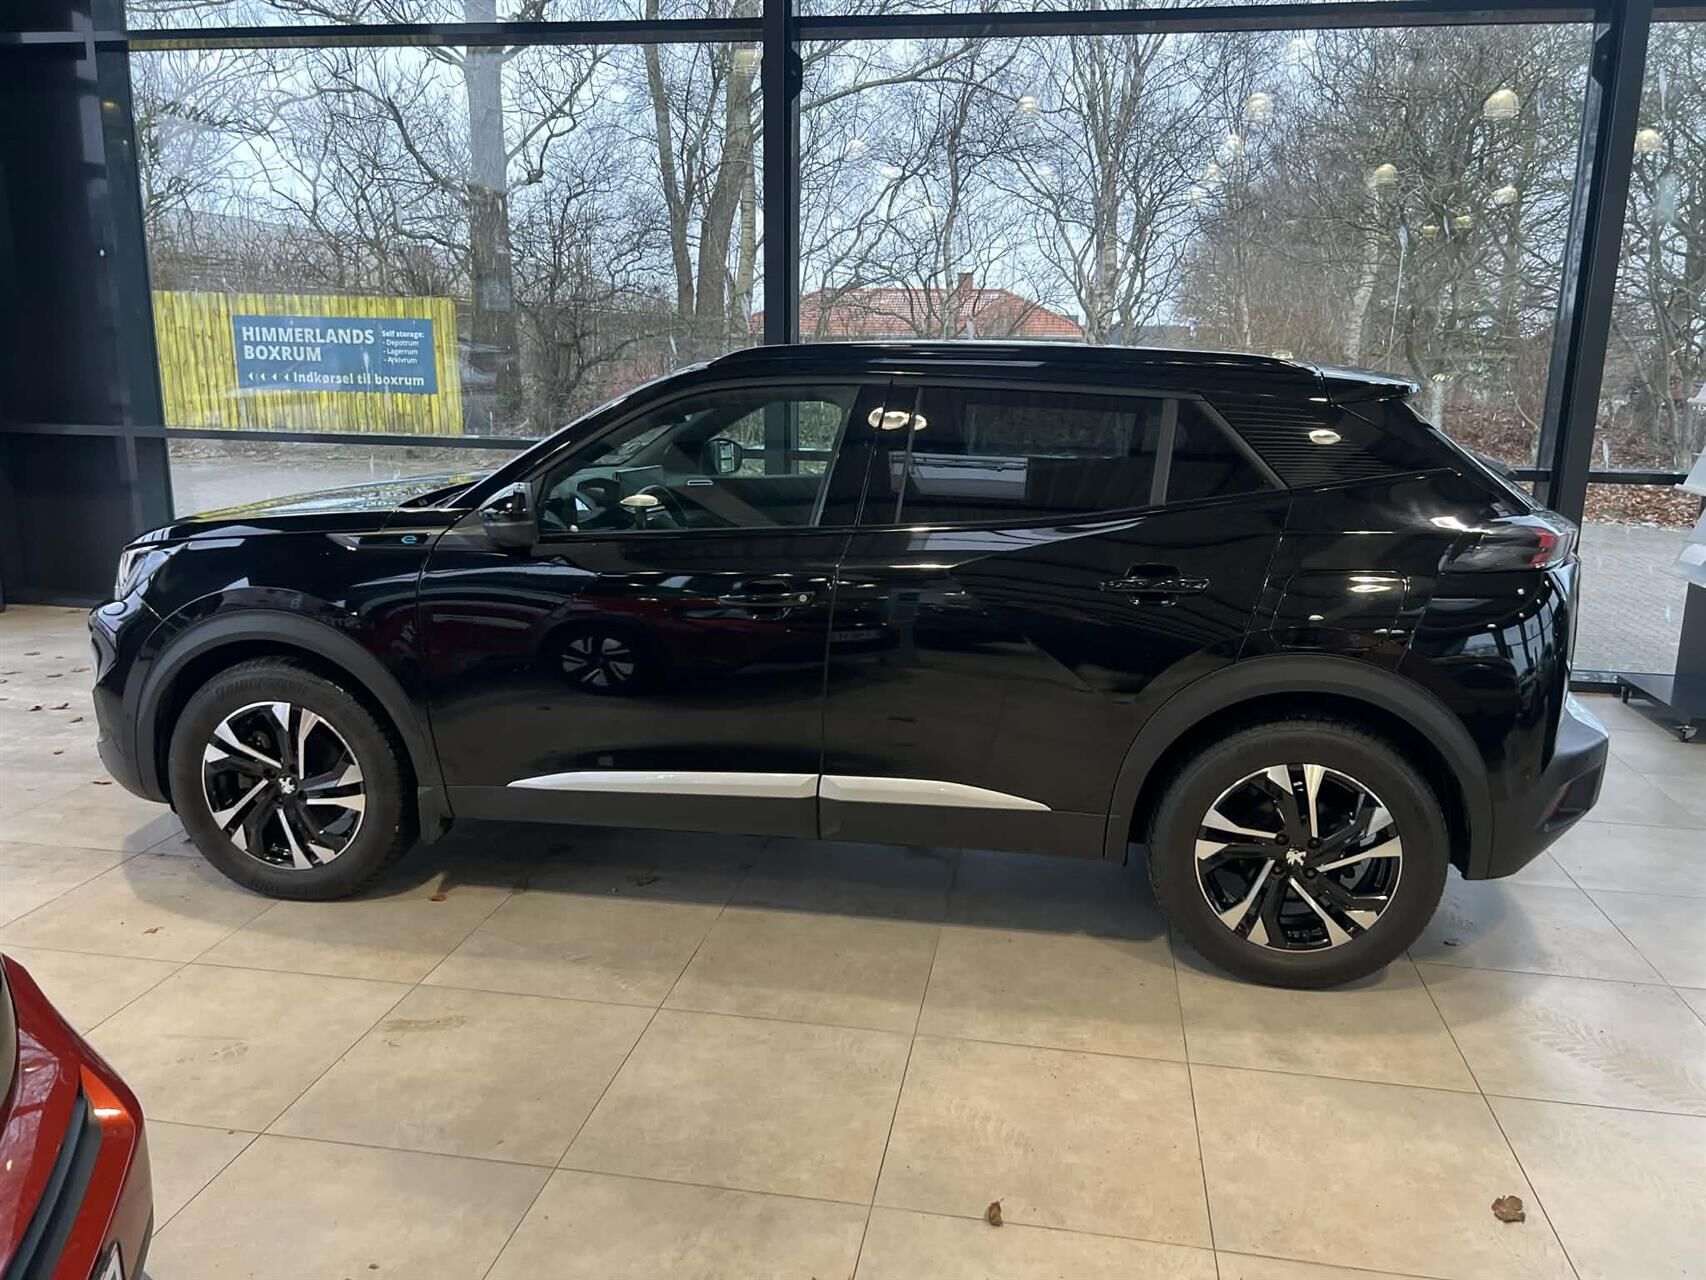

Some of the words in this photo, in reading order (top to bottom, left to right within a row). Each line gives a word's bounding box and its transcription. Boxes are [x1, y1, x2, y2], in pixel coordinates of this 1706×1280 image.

[242, 326, 375, 345] HIMMERLANDS
[382, 330, 395, 338] Self
[244, 345, 322, 362] BOXRUM
[293, 371, 354, 385] Indkørsel
[357, 372, 371, 385] til
[375, 373, 425, 387] boxrum
